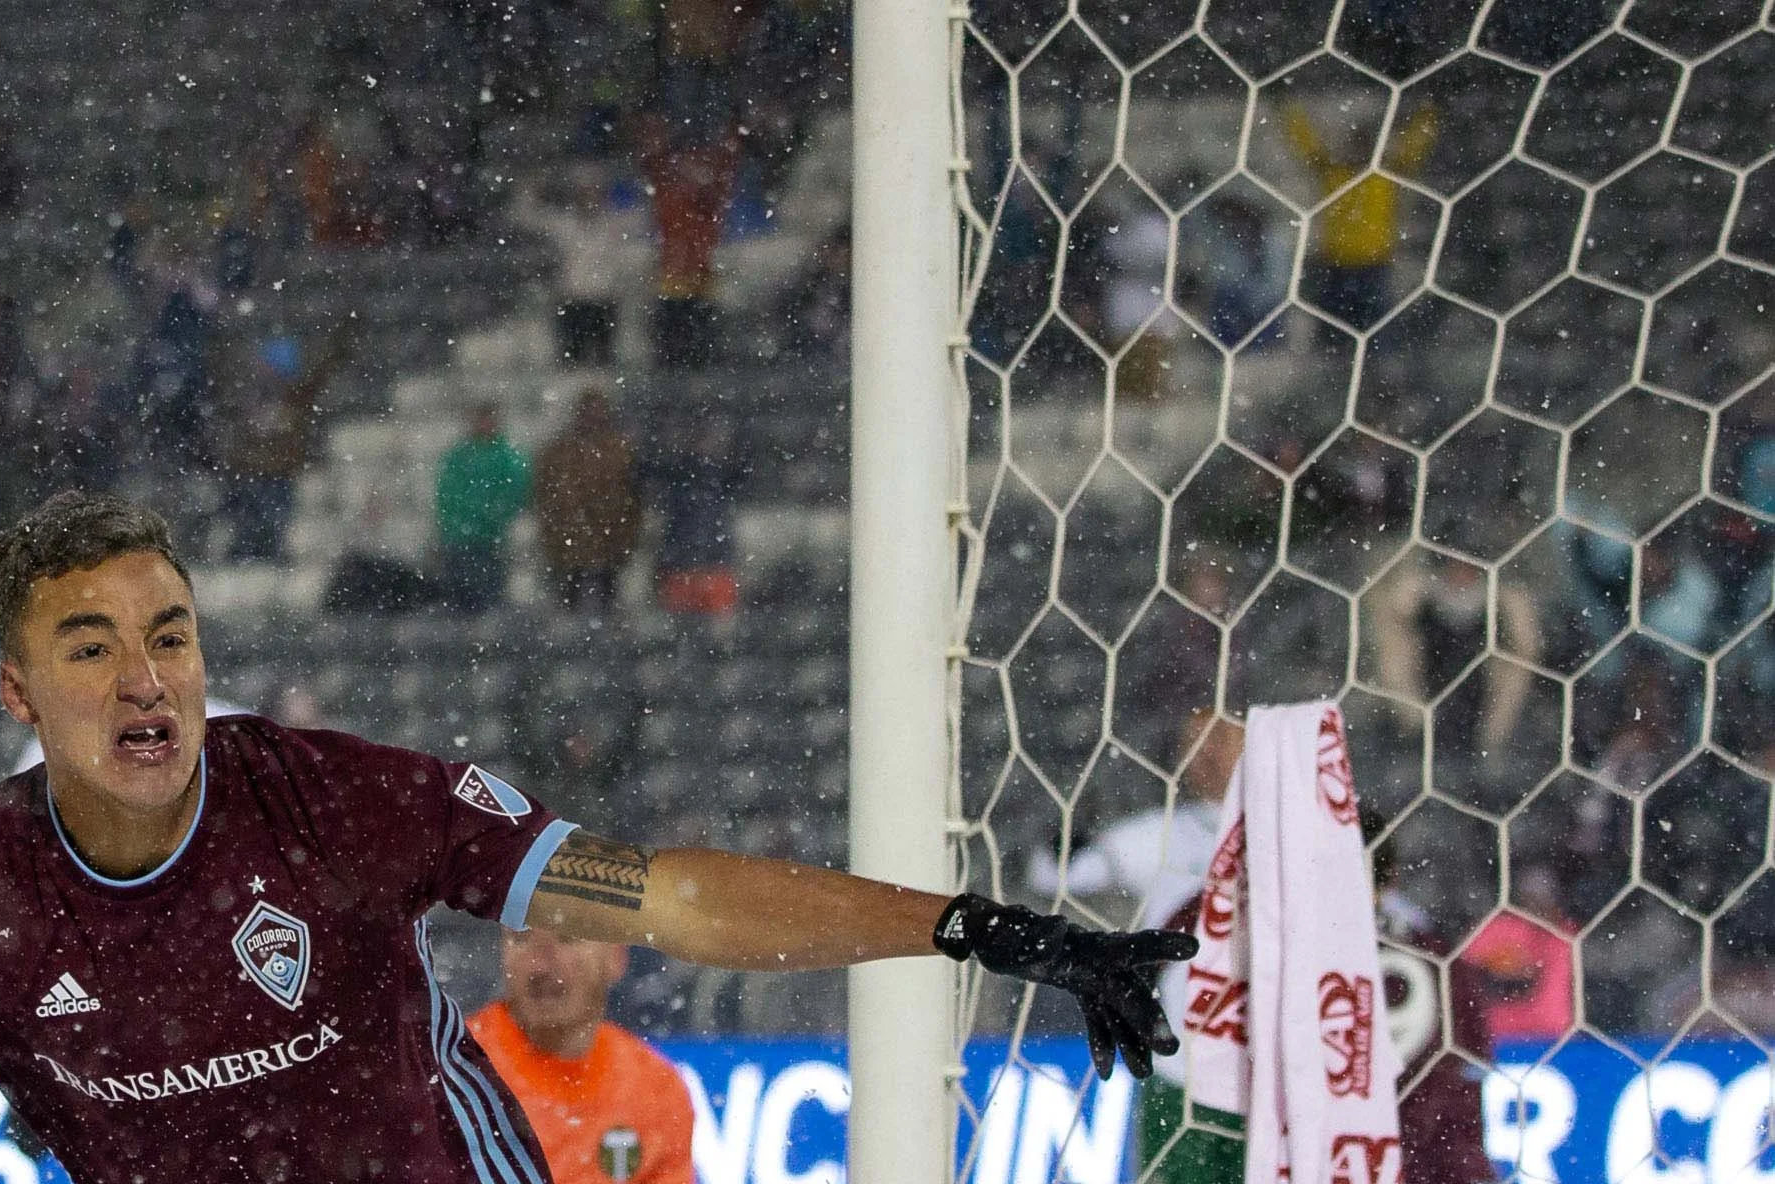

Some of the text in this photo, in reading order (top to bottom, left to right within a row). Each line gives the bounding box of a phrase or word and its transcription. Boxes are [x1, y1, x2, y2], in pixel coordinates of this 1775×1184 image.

[461, 778, 483, 802] MLS
[247, 929, 297, 952] COLORADO
[36, 998, 101, 1018] adidas
[34, 1023, 344, 1102] TRANSAMERICA
